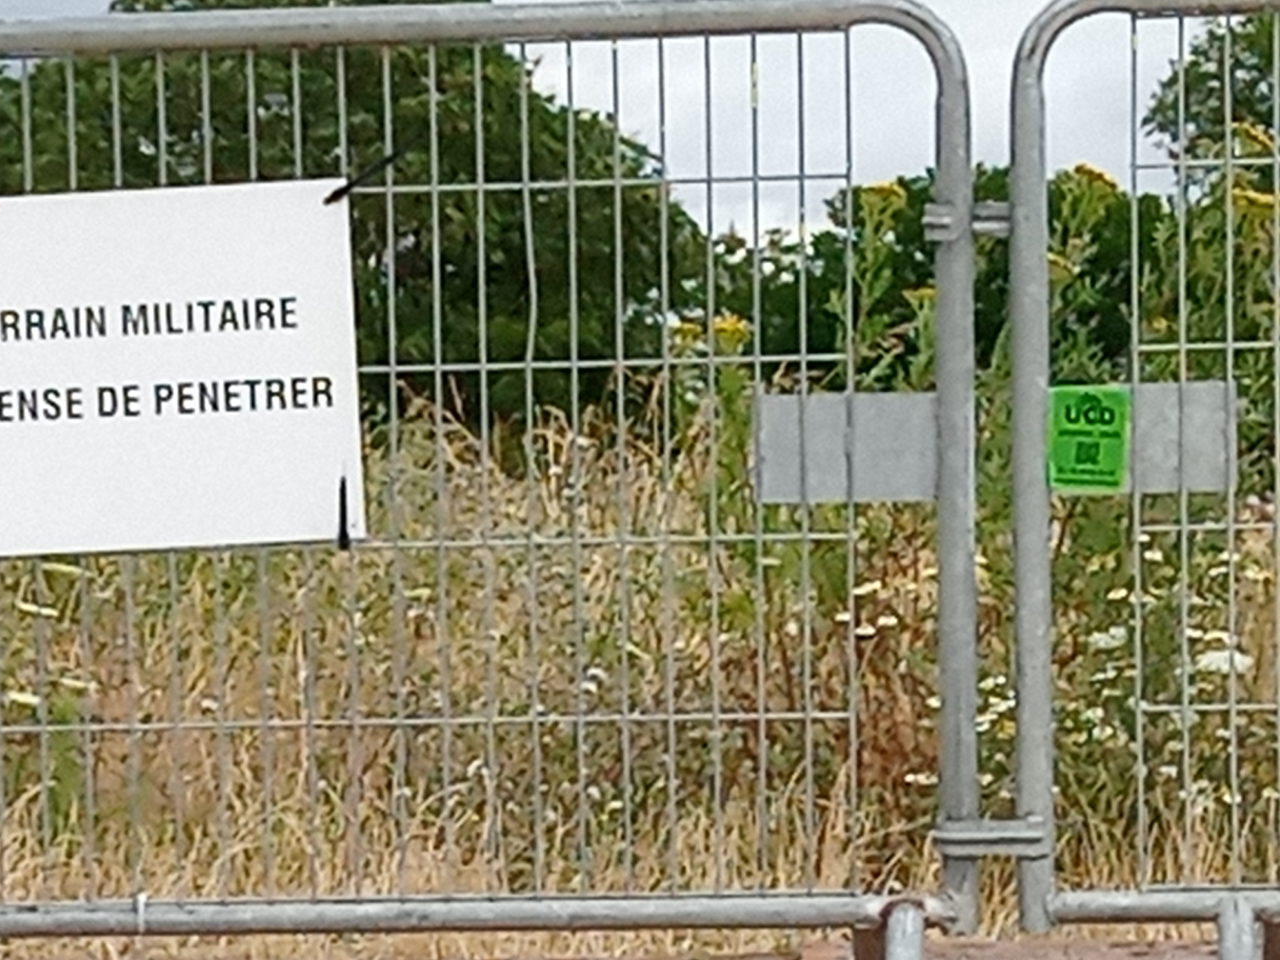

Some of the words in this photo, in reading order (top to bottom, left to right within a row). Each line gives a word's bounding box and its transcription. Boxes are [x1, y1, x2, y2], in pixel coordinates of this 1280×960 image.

[122, 297, 299, 336] MILITAIRE
[98, 385, 141, 418] DE
[154, 376, 335, 416] PENETRER
[1064, 404, 1116, 426] UCD
